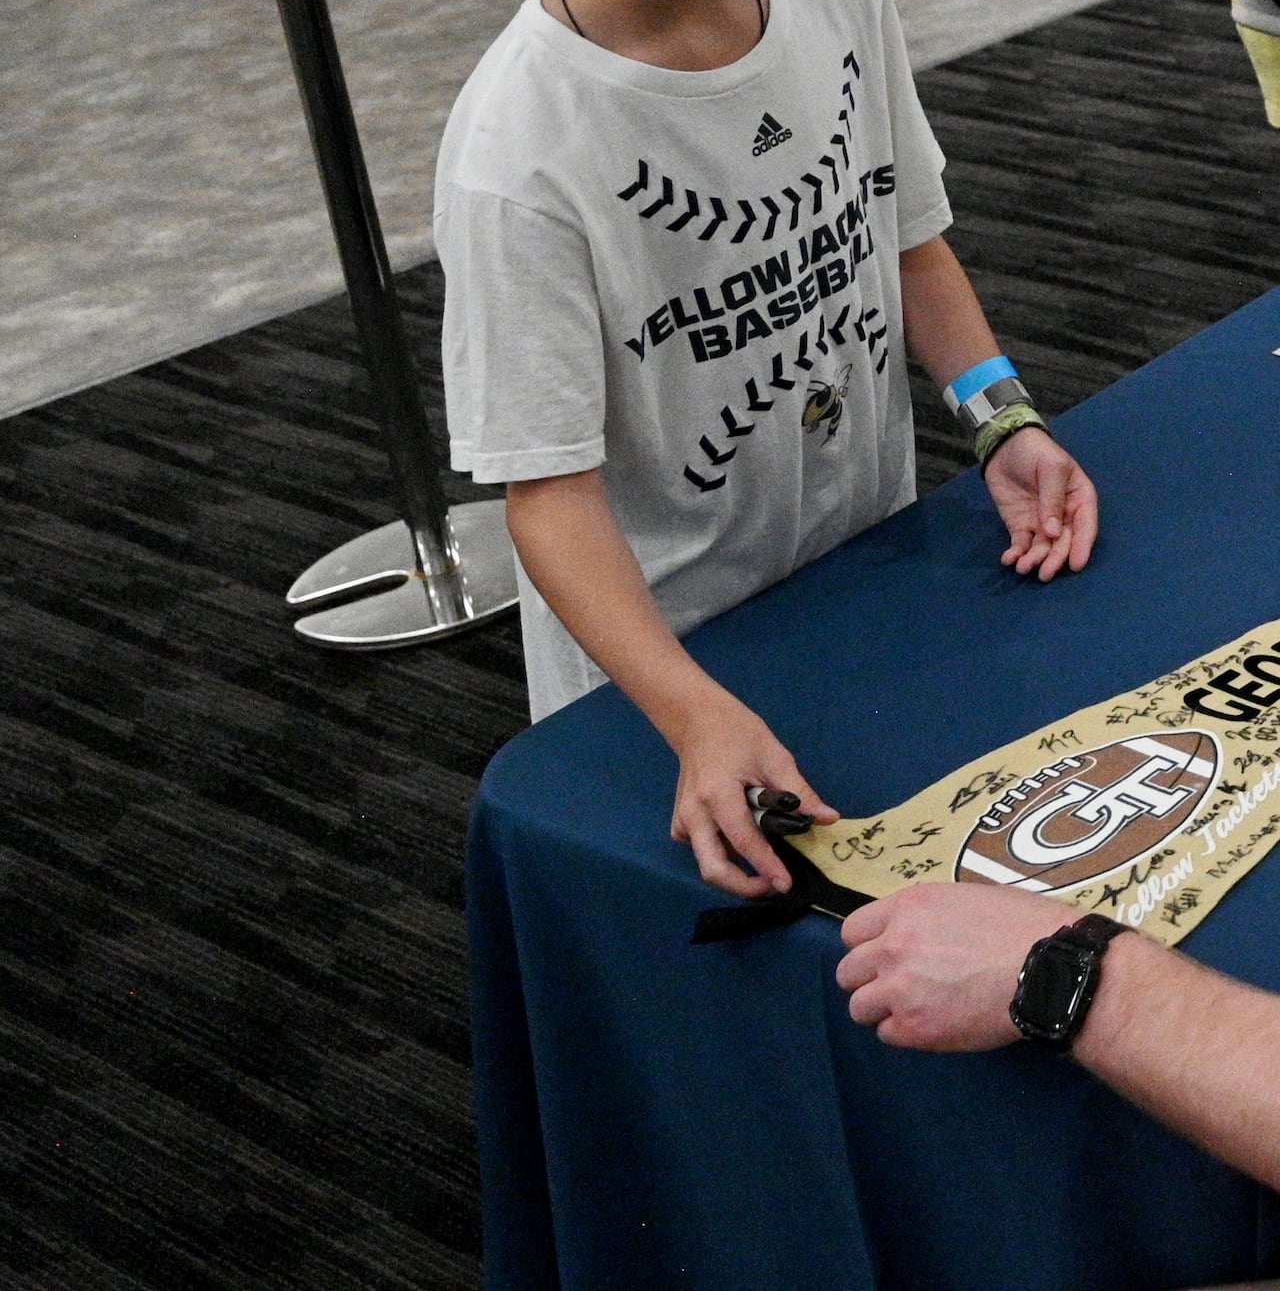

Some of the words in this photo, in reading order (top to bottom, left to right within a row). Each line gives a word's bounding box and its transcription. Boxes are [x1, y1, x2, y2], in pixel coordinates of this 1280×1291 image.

[752, 127, 794, 157] adidas
[624, 249, 793, 364] YELLOW
[797, 163, 896, 273] JACKTS
[1006, 753, 1199, 866] GT
